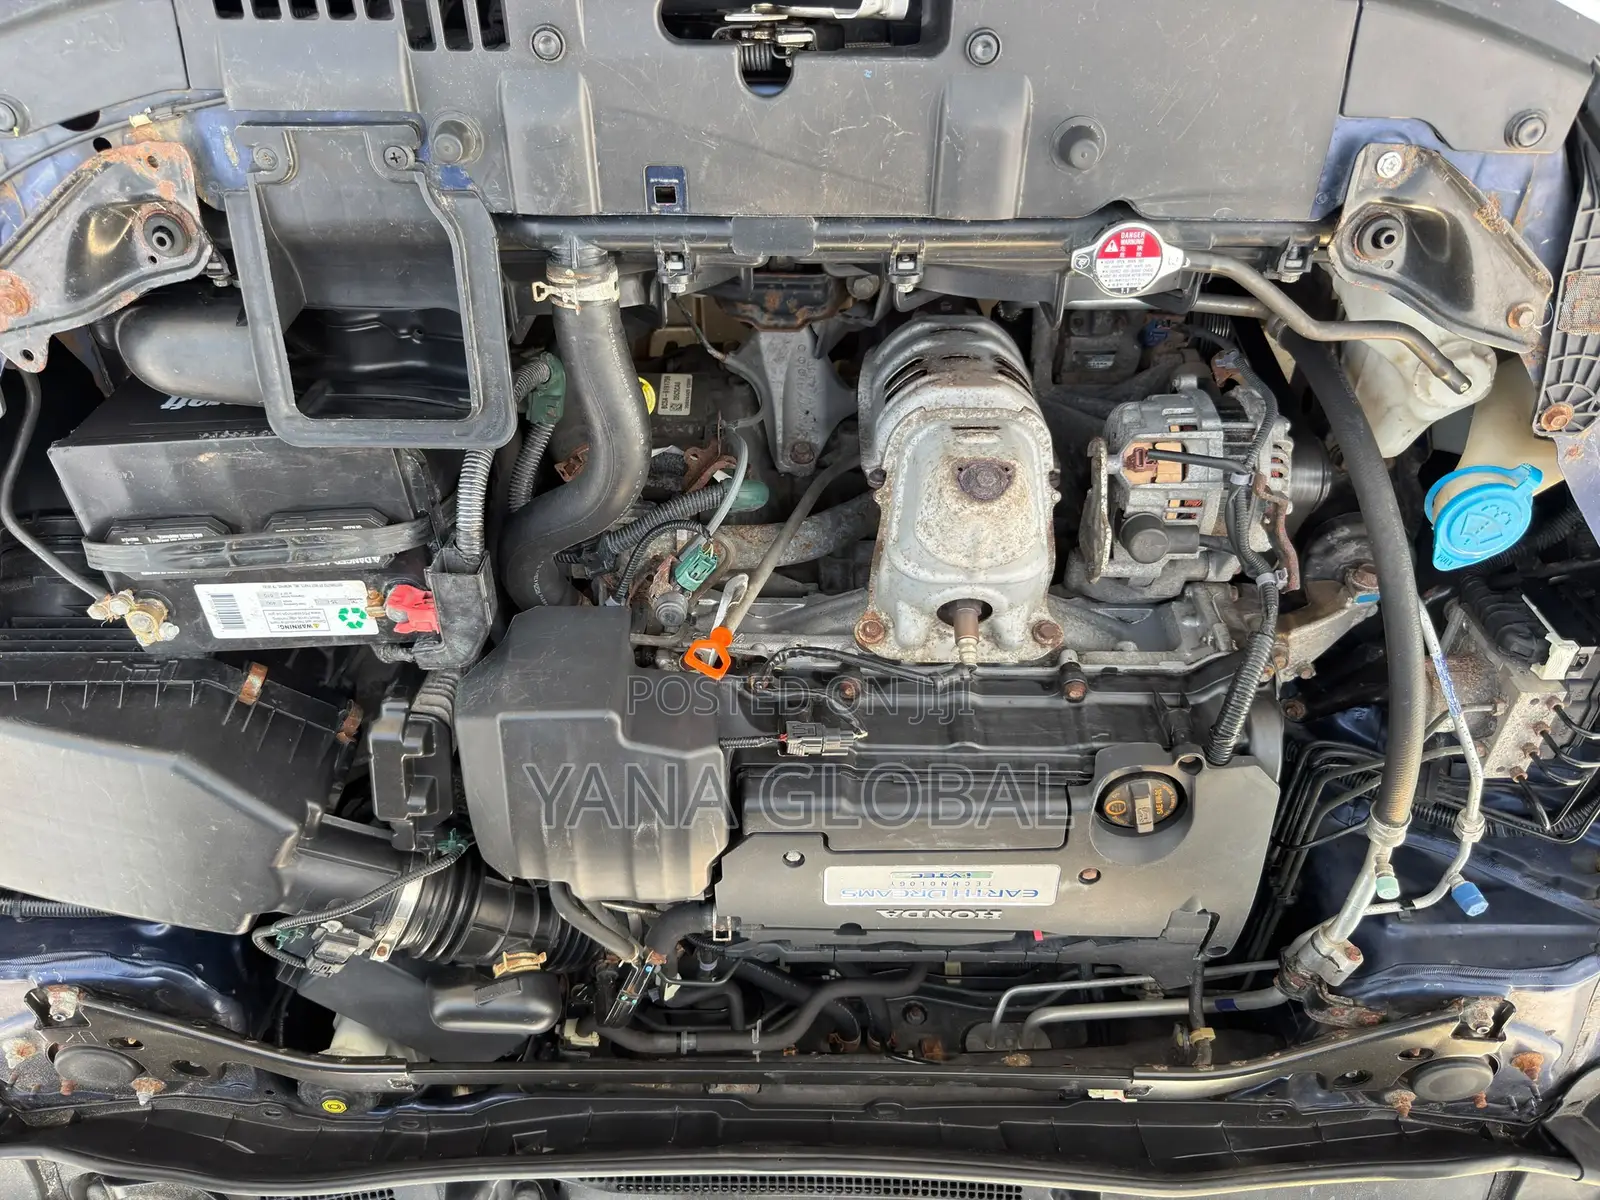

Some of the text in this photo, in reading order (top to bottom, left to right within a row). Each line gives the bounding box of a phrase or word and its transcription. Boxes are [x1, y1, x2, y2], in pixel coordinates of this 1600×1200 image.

[841, 888, 1039, 900] EARTH DREAMS
[875, 908, 1004, 920] HONDA
